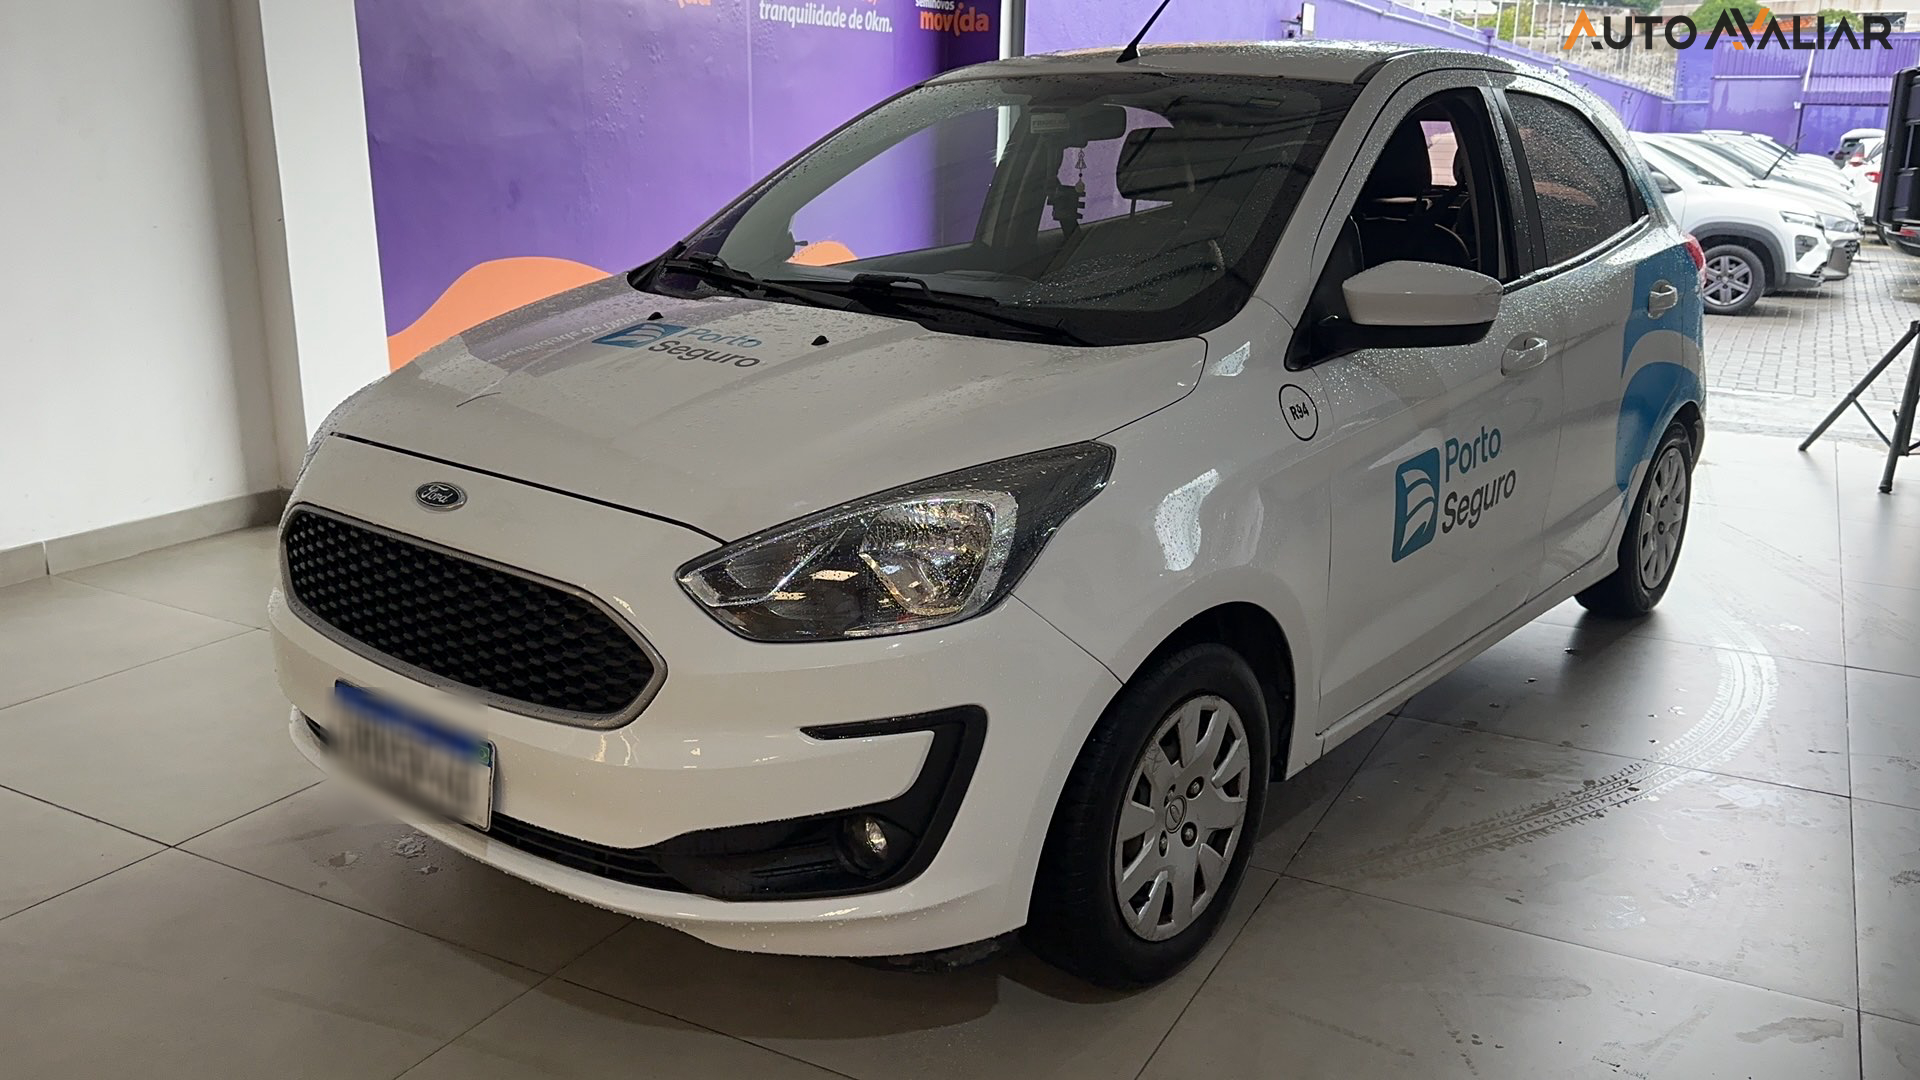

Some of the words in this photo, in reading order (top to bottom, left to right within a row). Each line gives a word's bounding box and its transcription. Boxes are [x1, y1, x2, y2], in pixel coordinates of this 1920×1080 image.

[759, 2, 847, 29] tranquilidade
[848, 8, 863, 30] de
[920, 2, 989, 36] movida
[678, 328, 762, 348] Porto
[648, 340, 760, 367] Seguro
[1289, 401, 1310, 420] R94
[1444, 426, 1501, 482] Porto
[421, 484, 453, 503] Ford
[1442, 469, 1516, 534] Seguro
